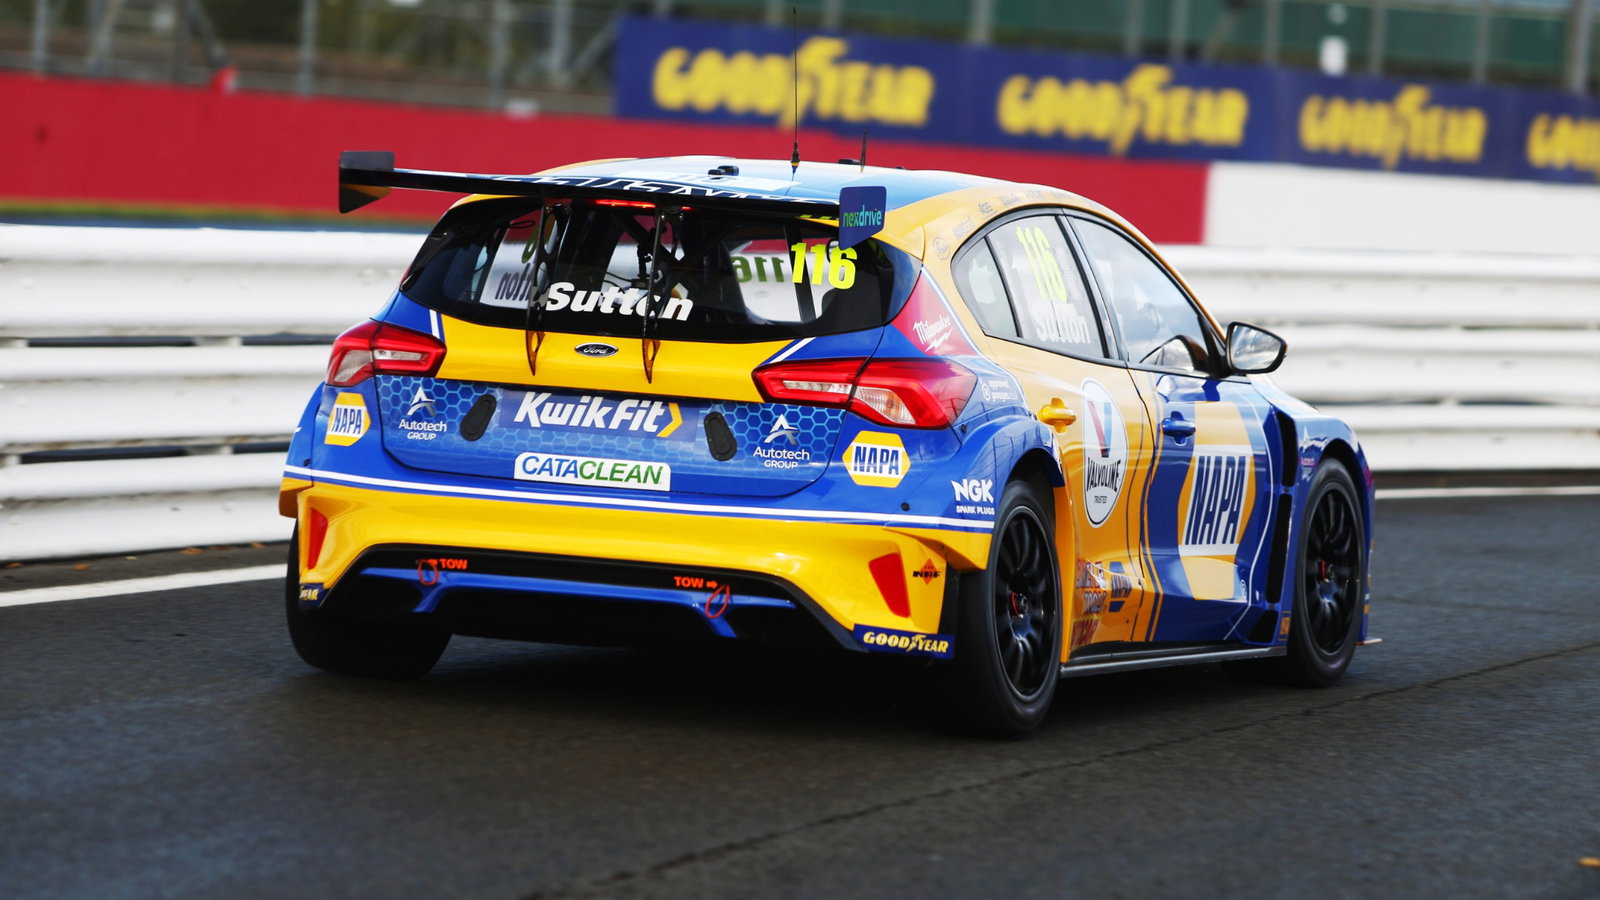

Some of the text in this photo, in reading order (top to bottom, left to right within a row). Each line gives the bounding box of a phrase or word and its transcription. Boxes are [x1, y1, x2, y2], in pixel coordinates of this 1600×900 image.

[842, 204, 883, 228] nexdrive
[791, 242, 858, 289] 116
[1016, 226, 1068, 302] 116
[545, 282, 694, 321] Sutton
[912, 314, 952, 345] Milwaukee
[331, 406, 364, 436] NAPA
[398, 418, 447, 432] Autotech
[407, 431, 436, 441] GROUP
[753, 446, 810, 461] Autotech
[764, 459, 798, 470] GROUP
[853, 445, 899, 476] NAPA
[522, 456, 663, 485] CATACLEAN
[1086, 457, 1121, 492] VALVOLINE
[951, 478, 995, 504] NGK
[1185, 455, 1246, 545] NAPA
[956, 505, 975, 515] SPARK
[439, 558, 468, 570] TOW
[673, 576, 703, 588] TOW
[863, 631, 949, 653] GOODYEAR
